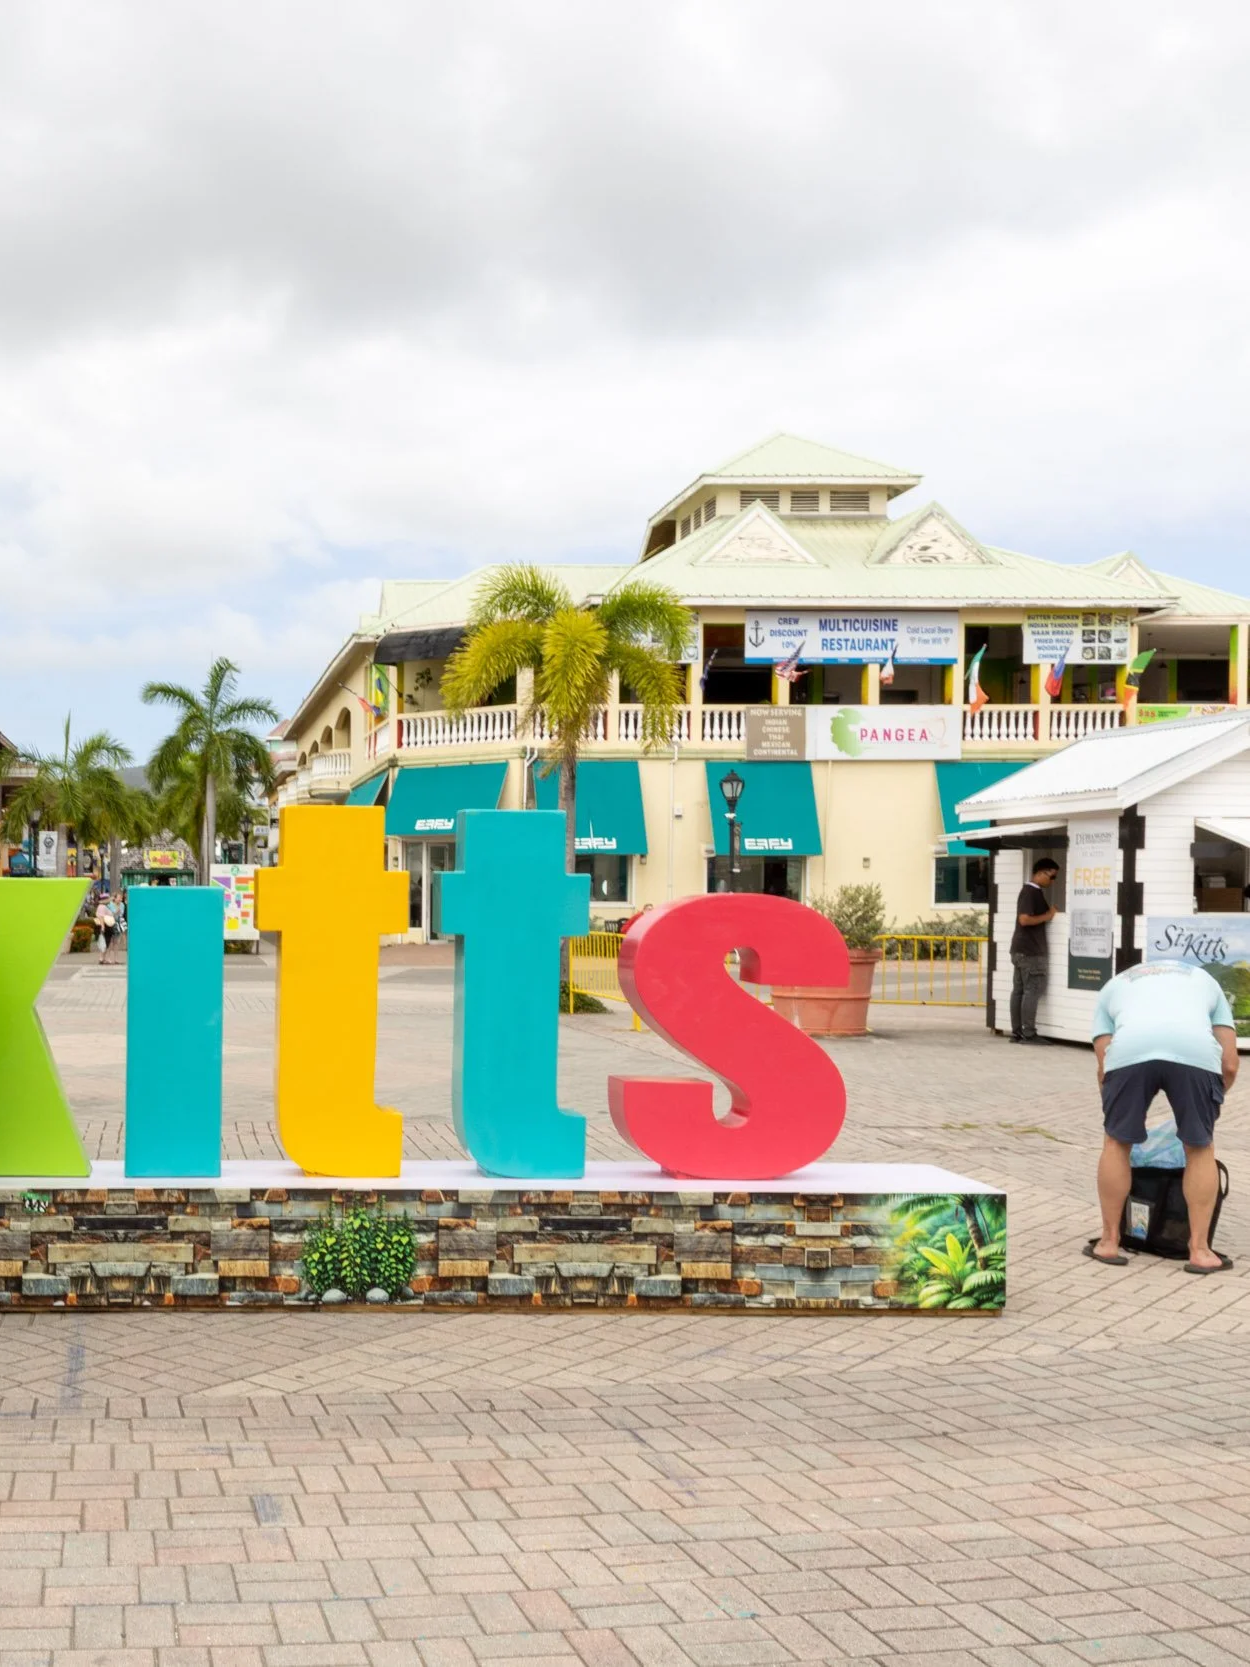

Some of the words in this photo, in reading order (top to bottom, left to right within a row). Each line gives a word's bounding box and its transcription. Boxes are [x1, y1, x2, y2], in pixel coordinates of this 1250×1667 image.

[777, 617, 800, 625] CREW
[818, 618, 899, 632] MULTICUISINE
[769, 629, 808, 637] DISCOUNT
[906, 626, 920, 634] Cold
[921, 626, 936, 634] Local
[937, 626, 954, 635] Beers
[781, 641, 796, 649] 10%
[821, 637, 896, 652] RESTAURANT
[750, 708, 769, 717] NOW
[770, 708, 802, 717] SERVING
[859, 728, 928, 741] PANGEA
[1073, 867, 1111, 888] FREE
